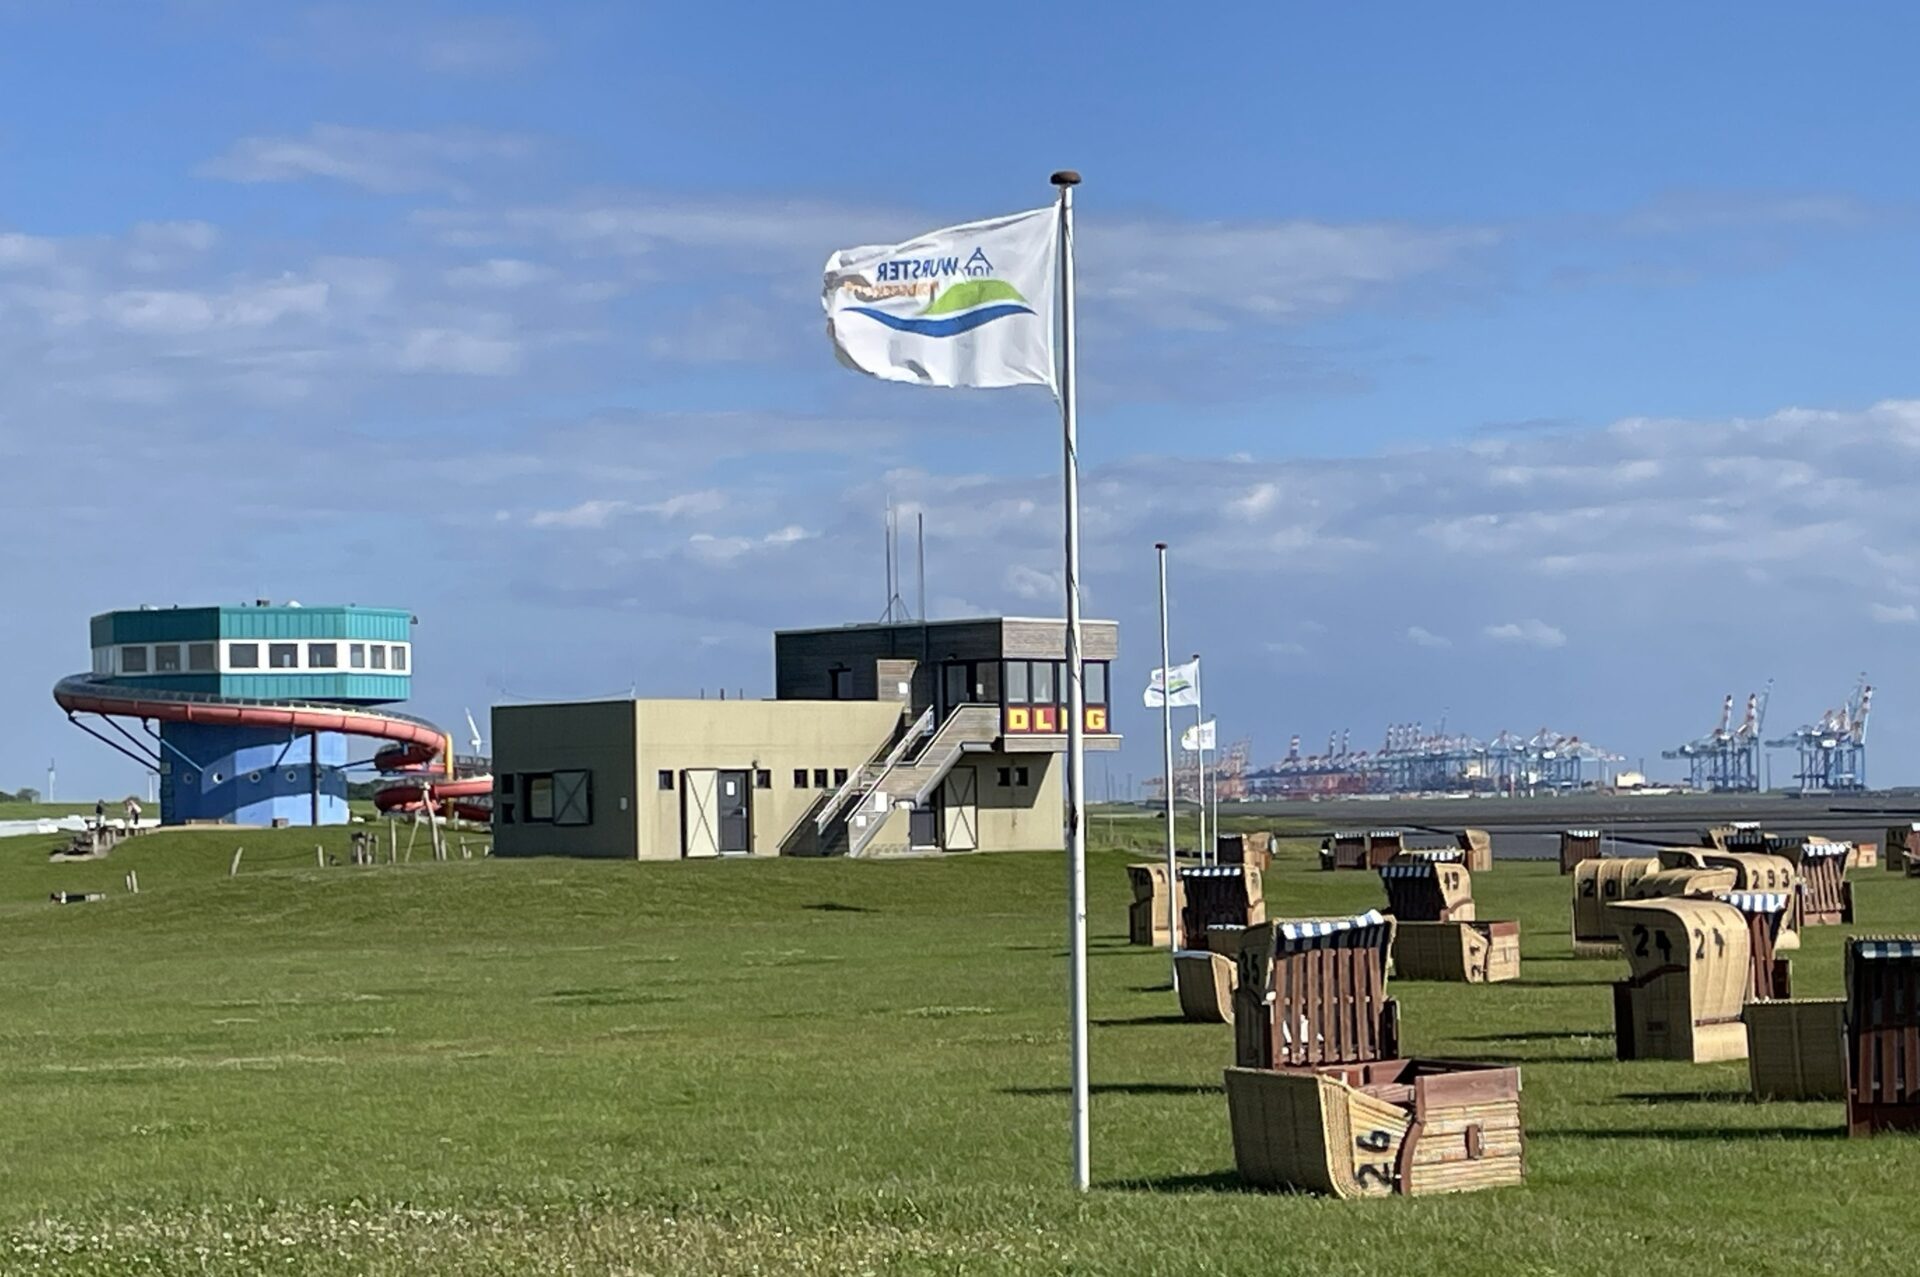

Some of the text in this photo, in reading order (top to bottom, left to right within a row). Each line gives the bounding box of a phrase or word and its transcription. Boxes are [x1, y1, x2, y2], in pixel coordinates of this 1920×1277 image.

[1443, 871, 1460, 890] 49
[1751, 868, 1790, 888] 293
[1632, 924, 1672, 962] 24
[1694, 928, 1726, 960] 24
[1355, 1129, 1392, 1190] 26
